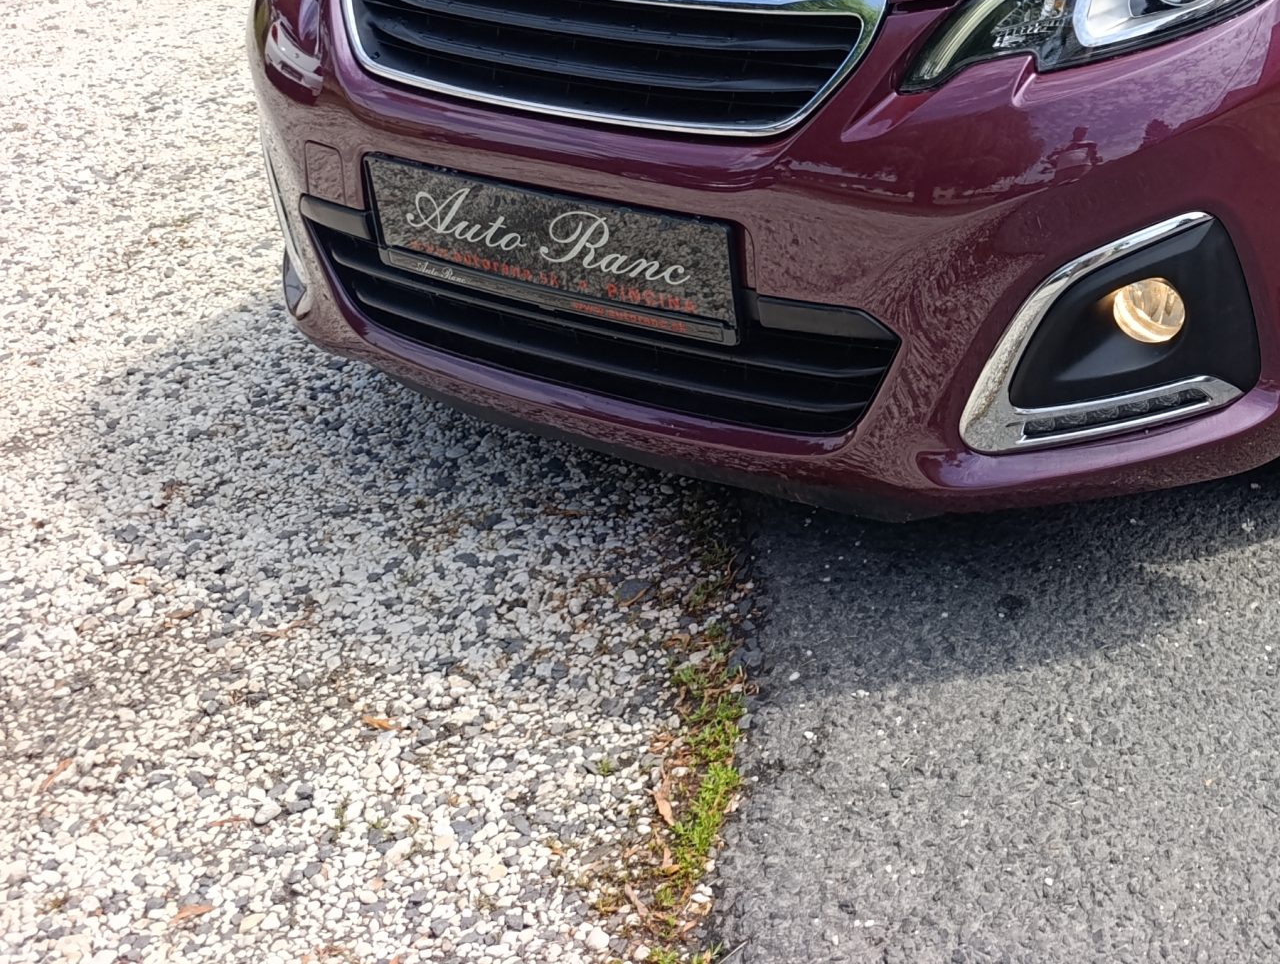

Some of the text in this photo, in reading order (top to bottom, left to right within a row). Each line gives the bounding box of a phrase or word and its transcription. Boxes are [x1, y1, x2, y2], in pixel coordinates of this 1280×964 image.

[406, 187, 691, 286] Auto Ranc
[415, 261, 440, 278] Auto
